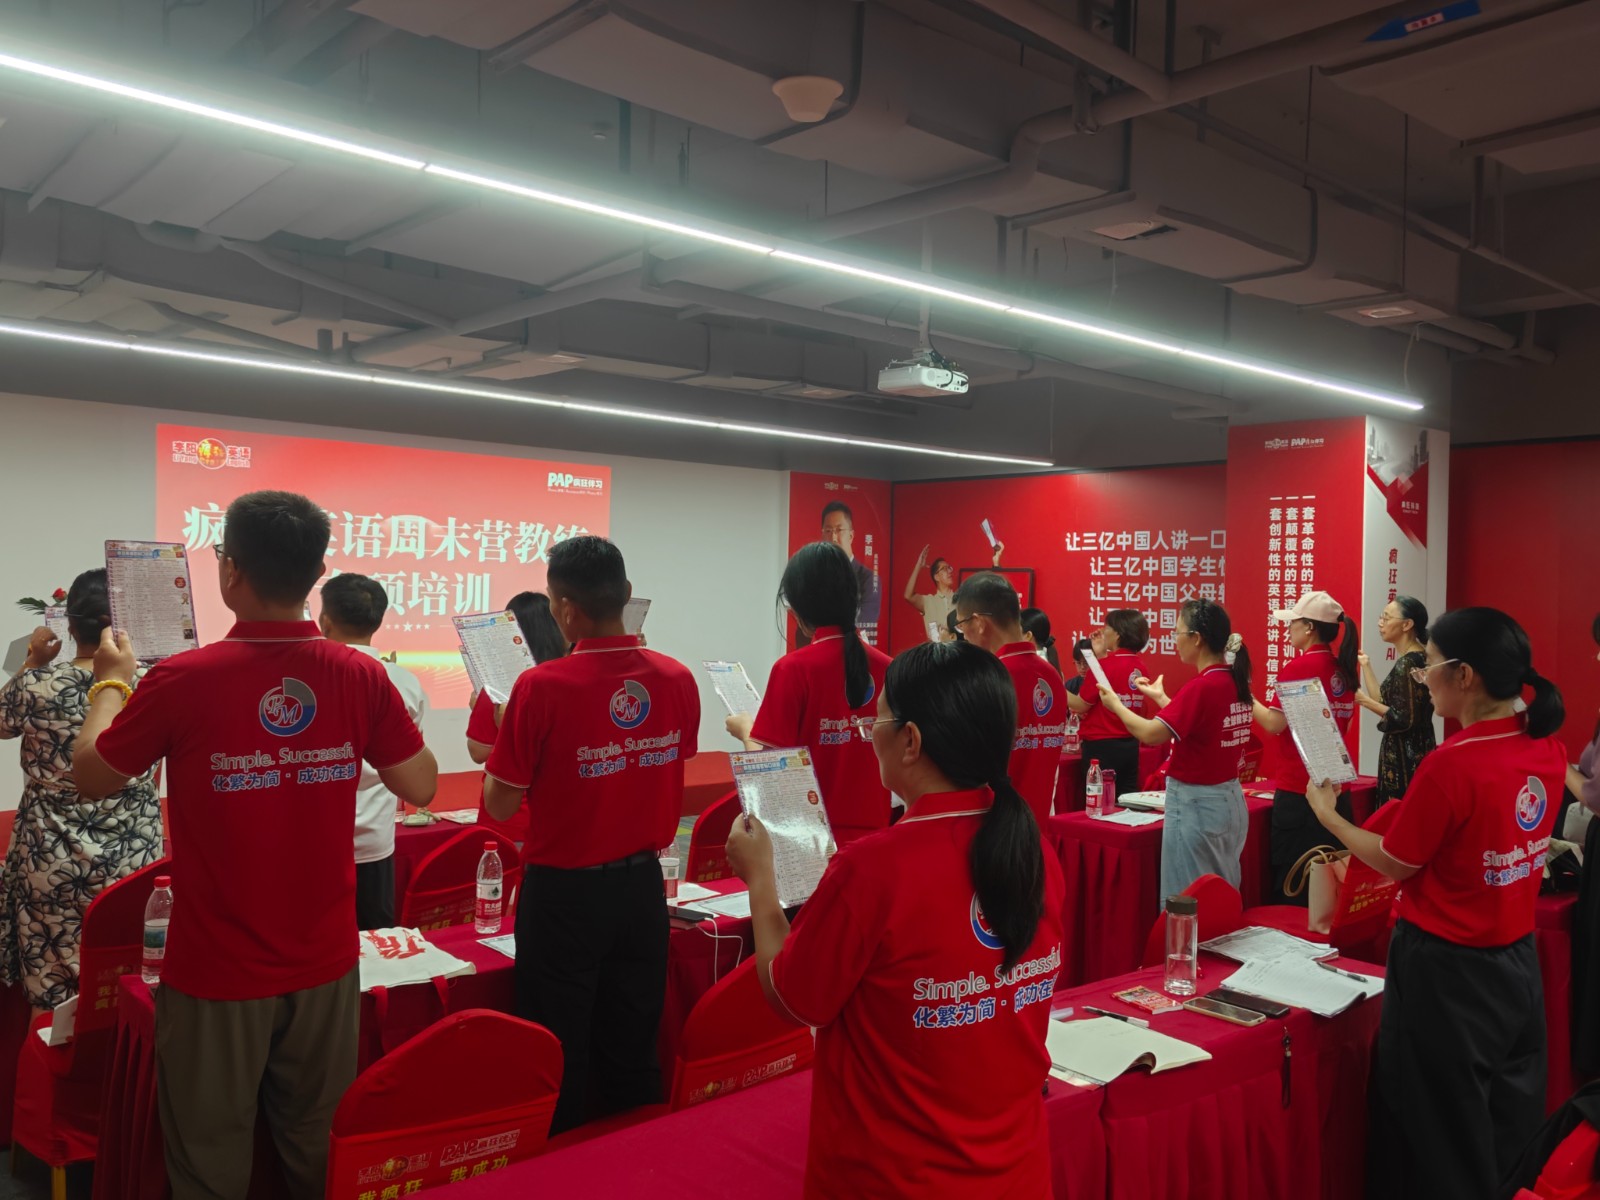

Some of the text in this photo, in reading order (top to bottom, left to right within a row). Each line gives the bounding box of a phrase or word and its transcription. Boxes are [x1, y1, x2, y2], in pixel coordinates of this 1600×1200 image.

[547, 472, 573, 488] PAP
[182, 502, 591, 564] 疯语周末营教
[1065, 529, 1227, 551] 让三亿中国人讲一口
[1088, 606, 1178, 630] 让中国
[210, 750, 276, 773] Simple.
[577, 741, 623, 761] Simple.
[913, 971, 991, 1004] Simple.
[449, 1154, 510, 1184] 我成功
